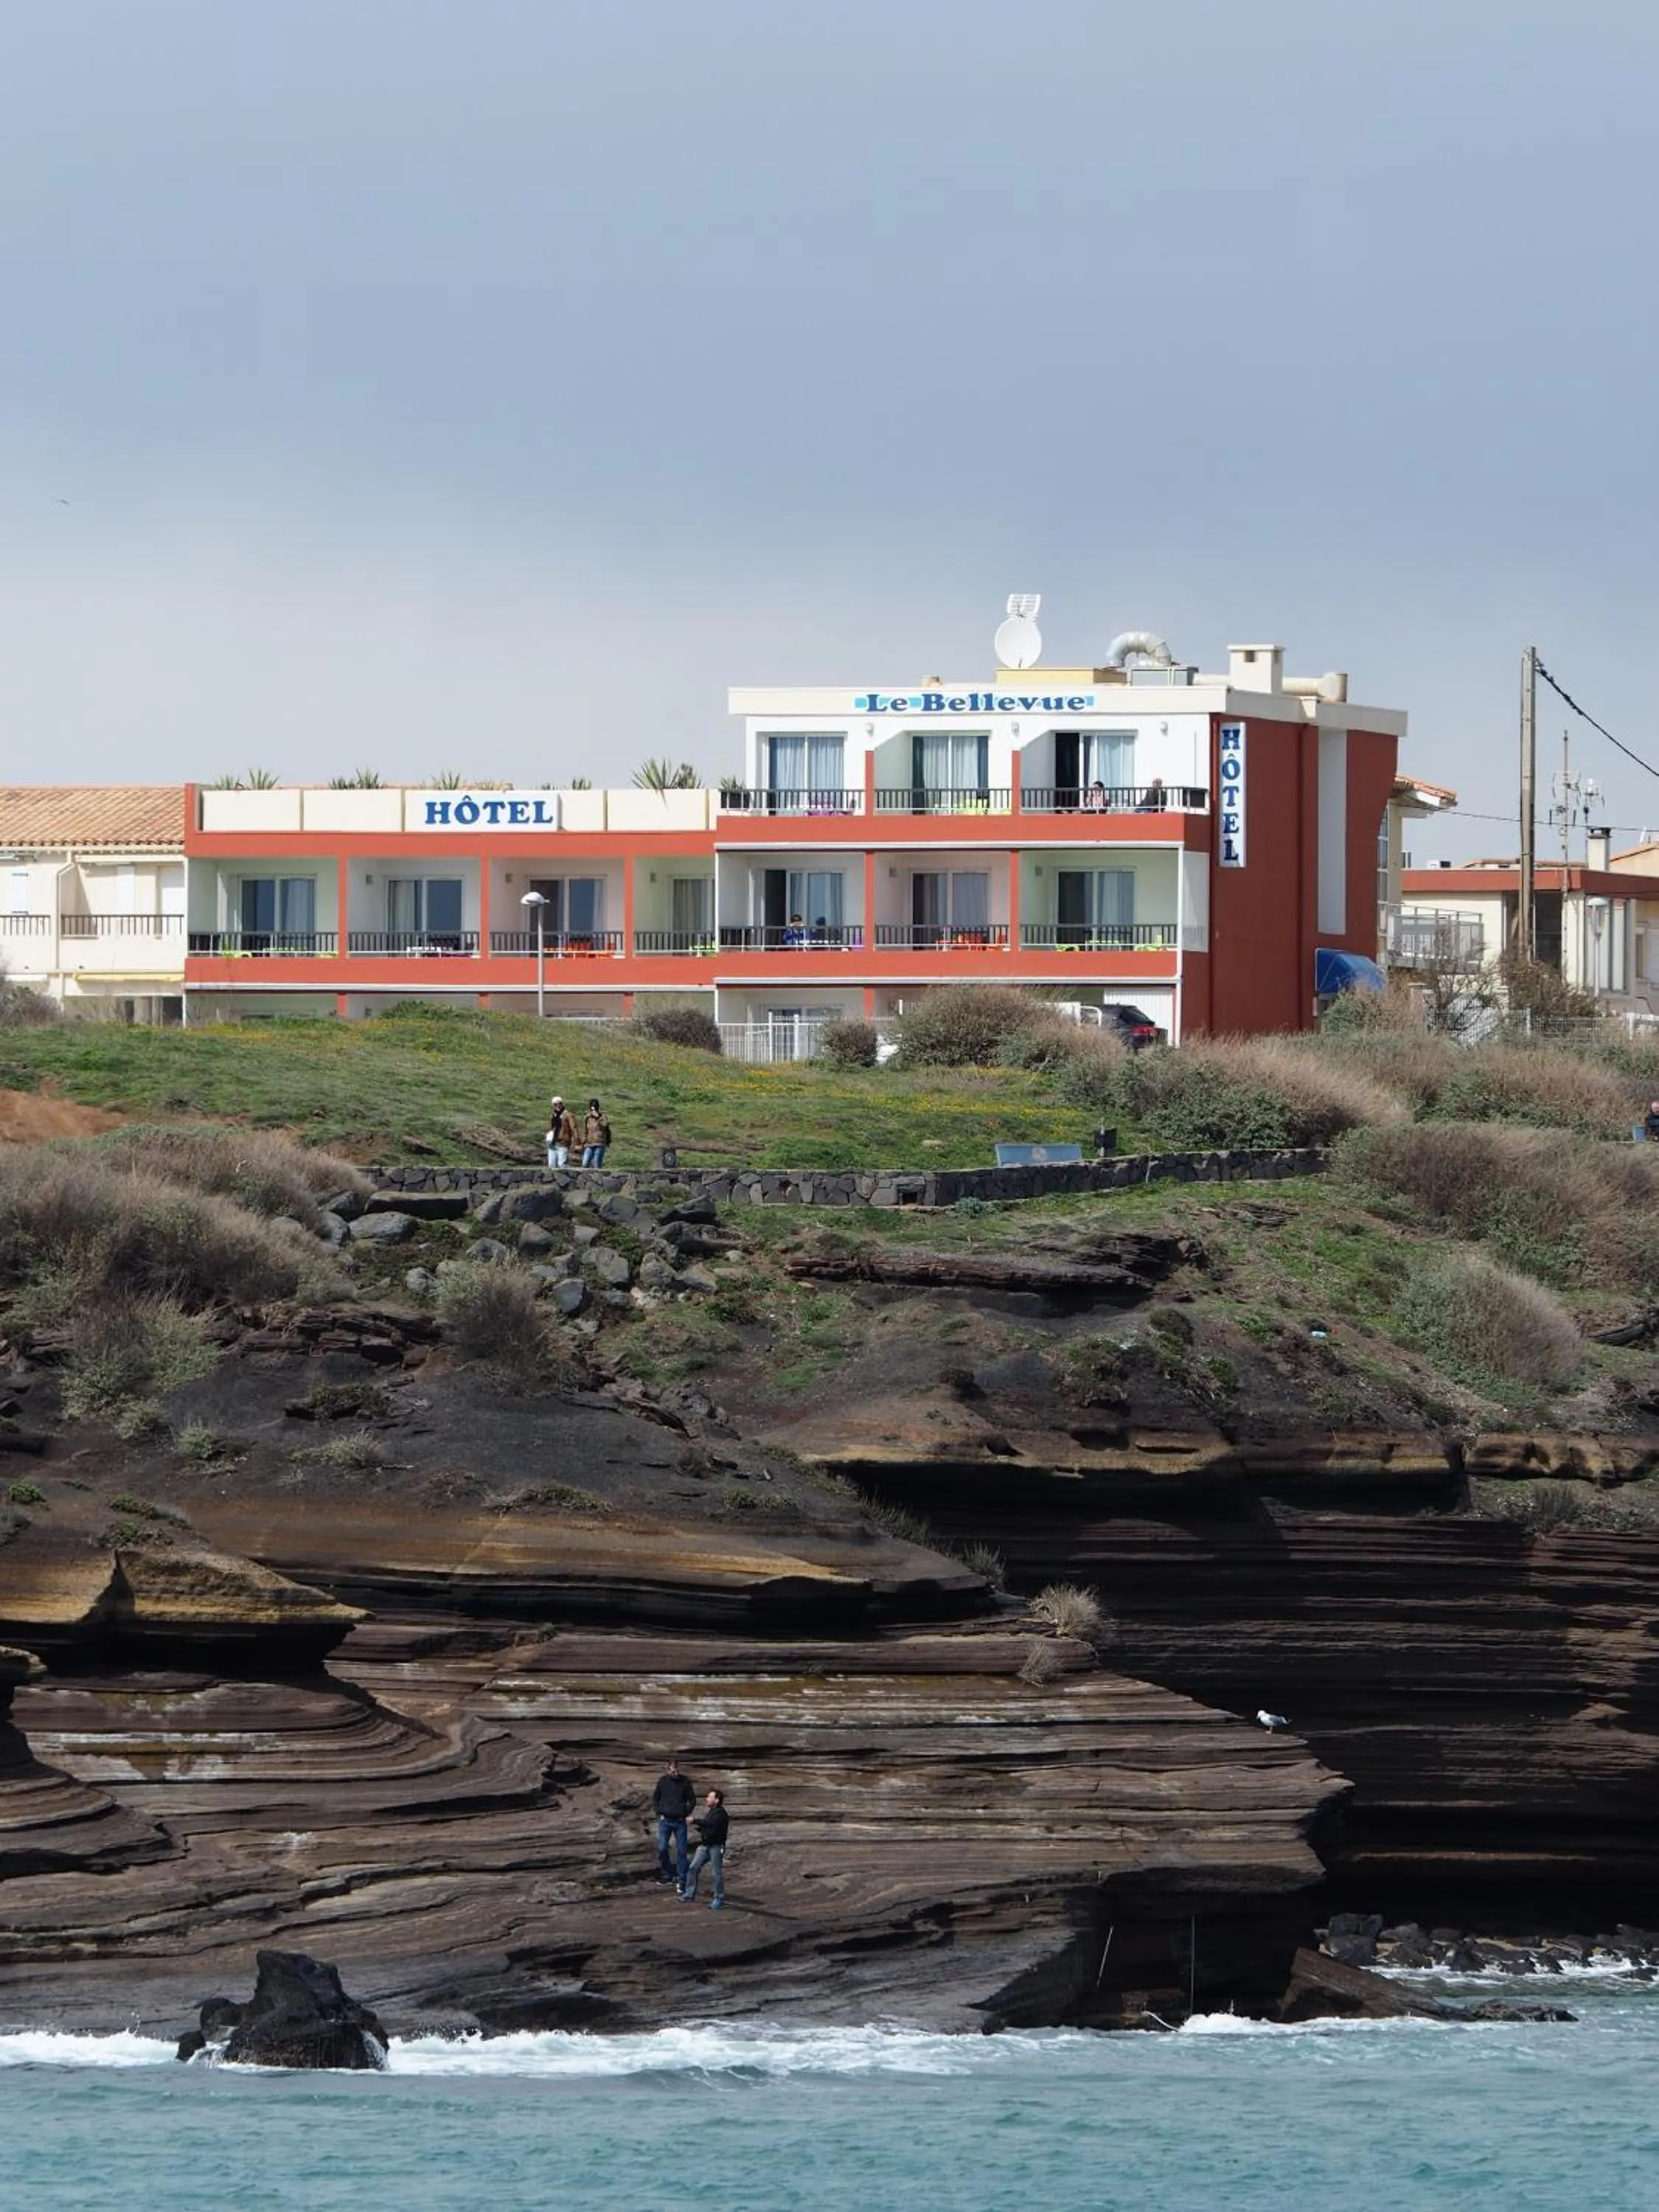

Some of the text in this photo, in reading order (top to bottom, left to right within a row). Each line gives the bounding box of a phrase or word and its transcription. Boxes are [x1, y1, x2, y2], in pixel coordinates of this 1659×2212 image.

[865, 693, 1086, 712] Le Bellevue
[1221, 728, 1240, 860] HÔTEL
[425, 795, 554, 824] HÔTEL
